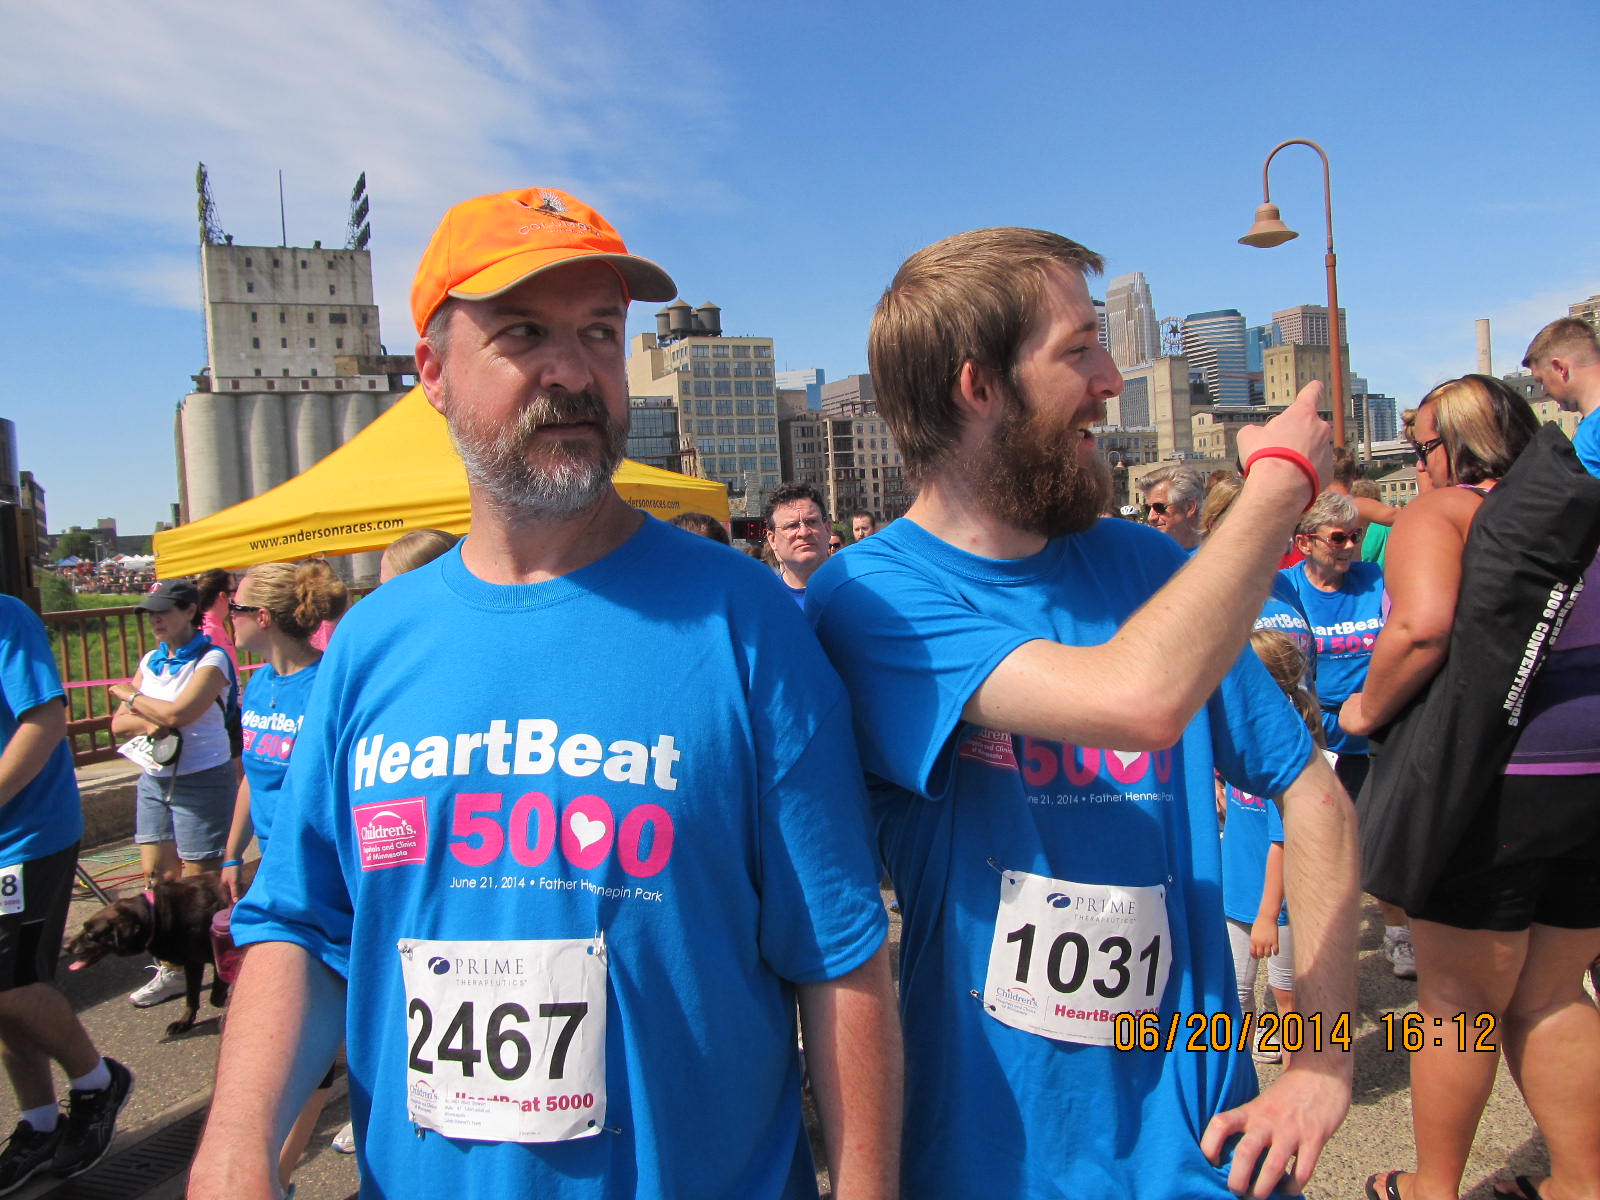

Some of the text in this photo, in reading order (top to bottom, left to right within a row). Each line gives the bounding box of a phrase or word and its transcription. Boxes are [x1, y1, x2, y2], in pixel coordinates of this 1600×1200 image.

[627, 496, 681, 509] dersonraces.com
[249, 518, 405, 550] www.andersonraces.com
[1503, 622, 1550, 711] CONVENTION
[353, 718, 681, 791] HeartBeat
[1057, 794, 1079, 805] 2014
[1090, 792, 1123, 803] Father
[449, 791, 675, 878] 5000
[449, 876, 476, 889] June
[479, 876, 498, 890] 21,
[501, 876, 526, 889] 2014
[539, 877, 577, 890] Father
[634, 887, 663, 903] Park
[1075, 896, 1136, 915] PRIME
[455, 958, 525, 975] PRIME
[1006, 923, 1161, 999] 1031
[408, 997, 589, 1082] 2467
[545, 1092, 594, 1112] 5000
